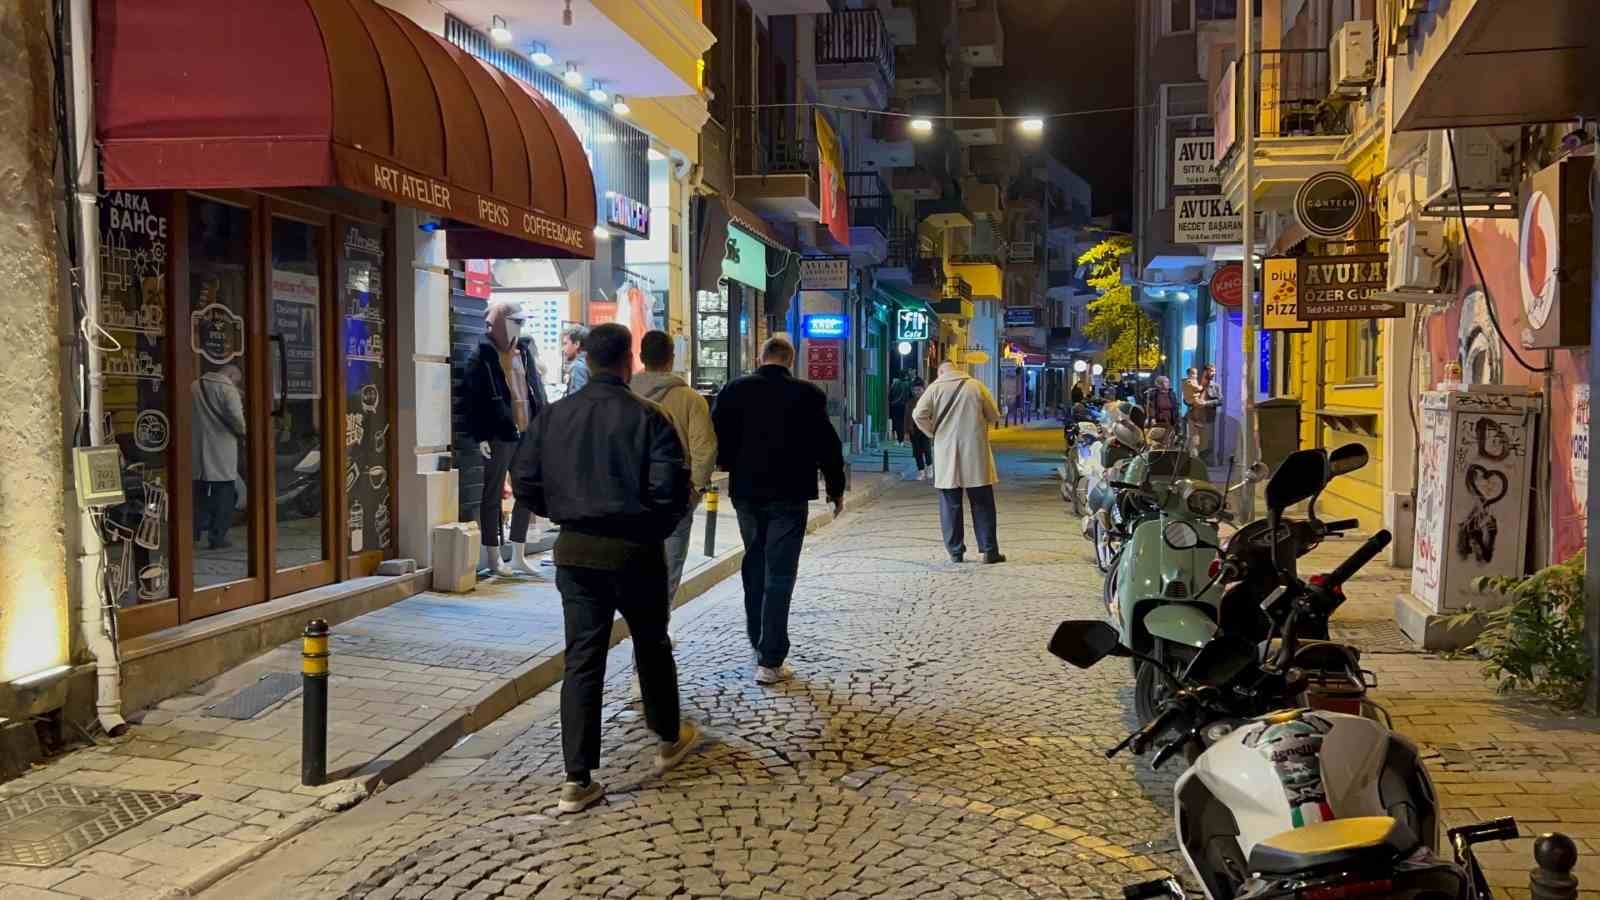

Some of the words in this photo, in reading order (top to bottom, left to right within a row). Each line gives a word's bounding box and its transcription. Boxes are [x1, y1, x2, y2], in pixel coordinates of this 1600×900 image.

[1178, 142, 1215, 161] AVU
[374, 163, 400, 194] ART
[401, 175, 452, 211] ATELİER
[477, 193, 510, 227] İPEK'S
[522, 212, 584, 250] COFFEE&CAKE
[1179, 199, 1241, 218] AVUKA
[109, 207, 167, 240] BAHÇE
[1306, 262, 1388, 285] AVUKA
[1304, 287, 1345, 302] ÖZER
[1266, 303, 1296, 316] PİZZ
